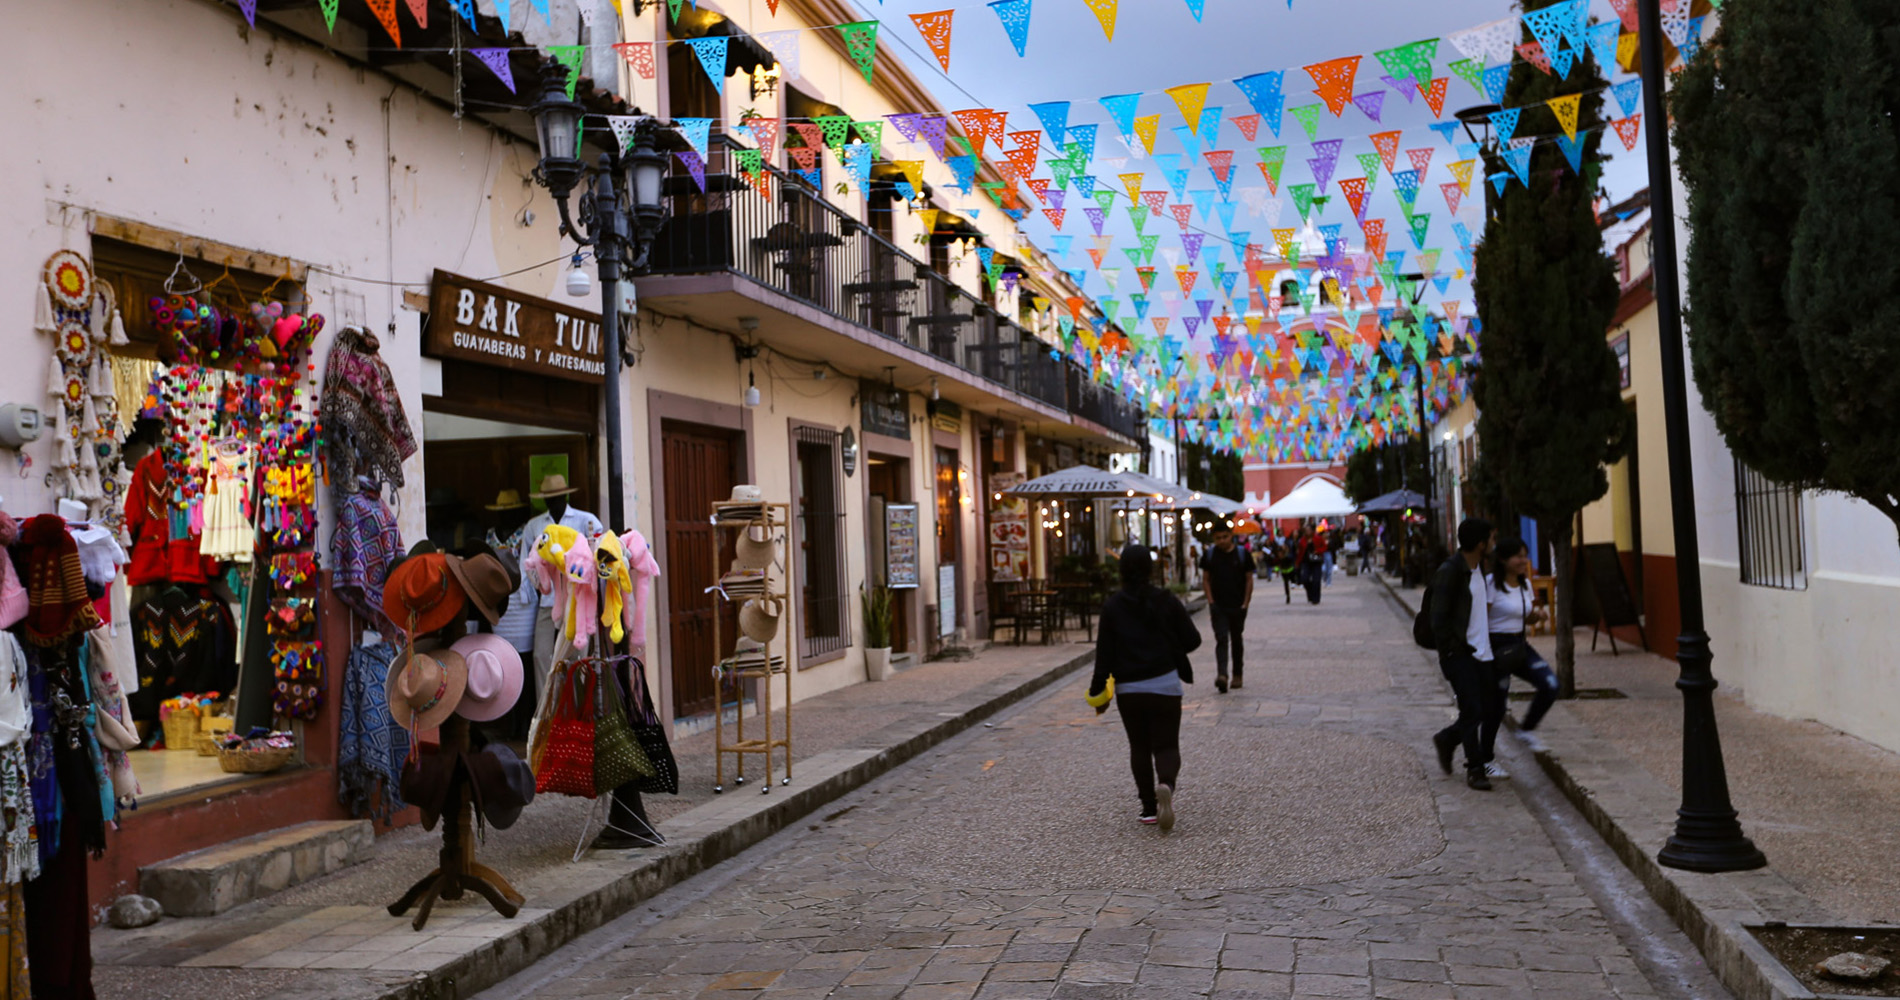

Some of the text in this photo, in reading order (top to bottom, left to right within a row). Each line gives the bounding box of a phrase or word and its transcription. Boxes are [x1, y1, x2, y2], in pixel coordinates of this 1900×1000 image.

[456, 288, 600, 355] BAK TUN
[453, 331, 605, 376] GUAYABERAS Y ARTESANIAS
